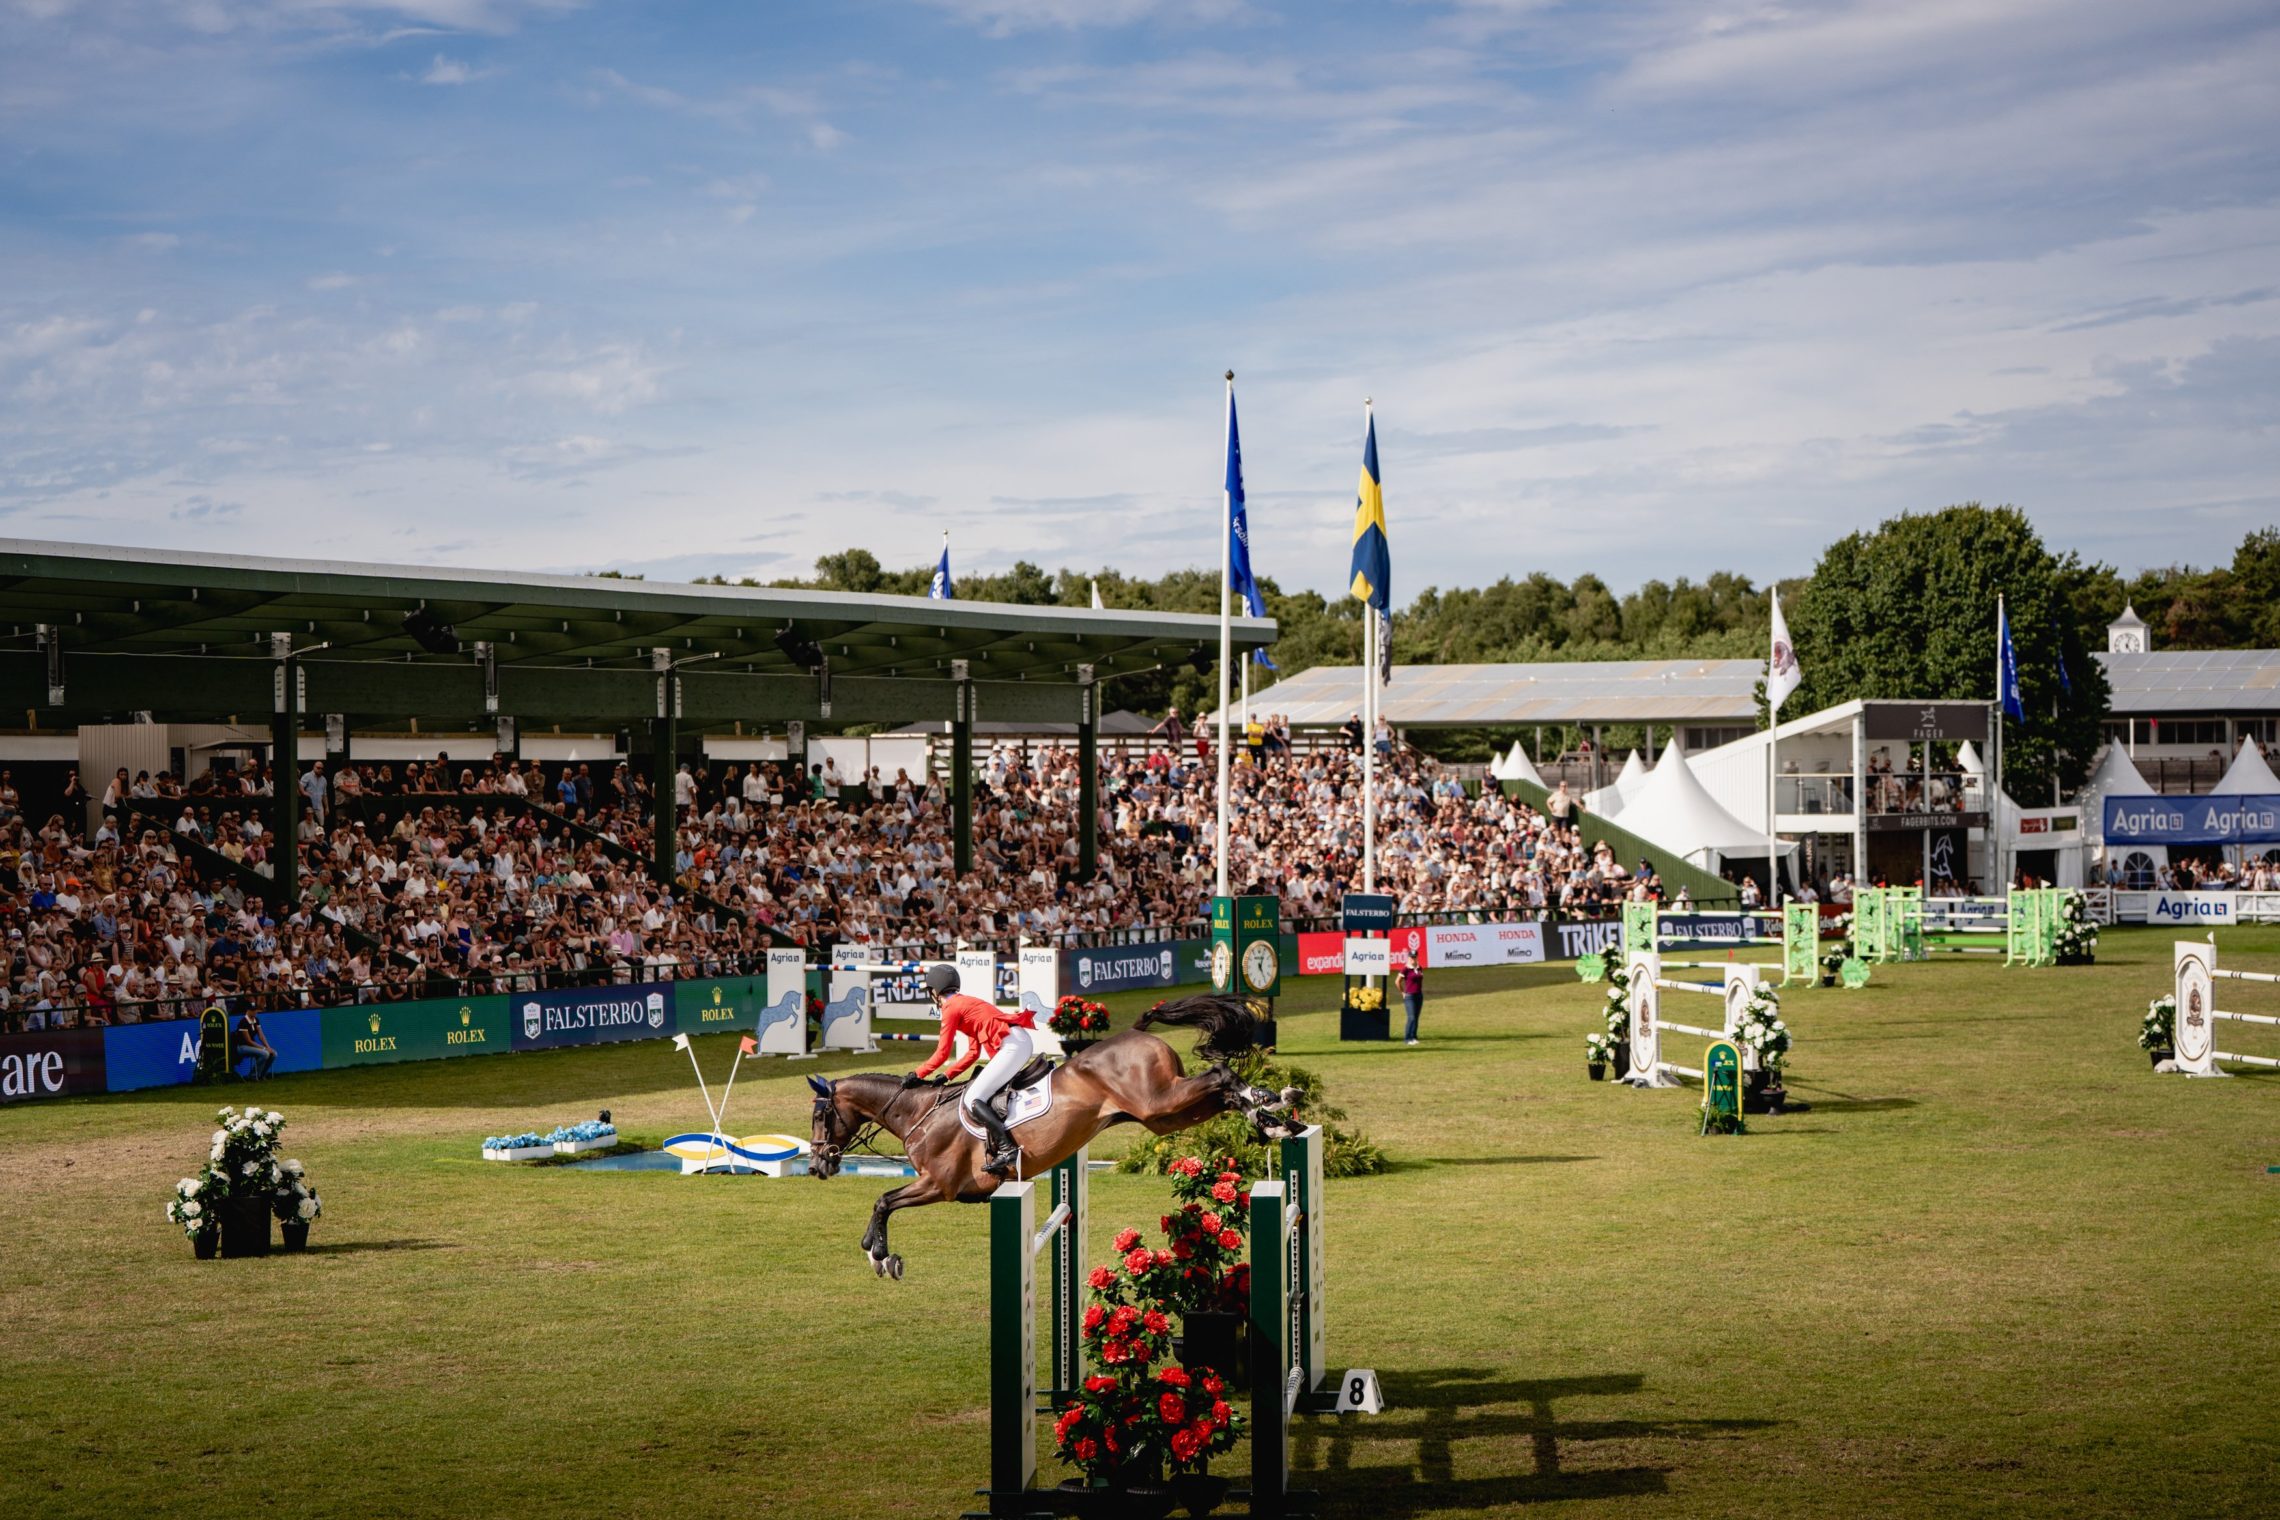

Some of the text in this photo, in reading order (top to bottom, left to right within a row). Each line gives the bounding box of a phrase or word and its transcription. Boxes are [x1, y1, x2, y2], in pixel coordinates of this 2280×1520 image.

[1914, 728, 1943, 738] FAGER
[1901, 816, 1957, 826] FAGERBITS.COM
[2112, 808, 2168, 835] Agria
[2204, 807, 2258, 834] Agria
[1345, 909, 1390, 917] FALSTERBO
[2156, 897, 2211, 919] Agria
[1214, 920, 1229, 928] ROLEX
[1244, 920, 1273, 928] ROLEX
[1436, 932, 1477, 943] HONDA
[1498, 930, 1536, 939] HONDA
[771, 953, 793, 964] Agria
[836, 949, 858, 960] Agria
[1023, 953, 1045, 963] Agria
[1351, 952, 1377, 962] Agria
[960, 957, 983, 966] Agria
[1093, 958, 1159, 981] FALSTERBO
[545, 1001, 643, 1031] FALSTERBO
[701, 1008, 734, 1022] ROLEX
[447, 1029, 486, 1044] ROLEX
[355, 1037, 397, 1053] ROLEX
[1349, 1378, 1365, 1406] 8
